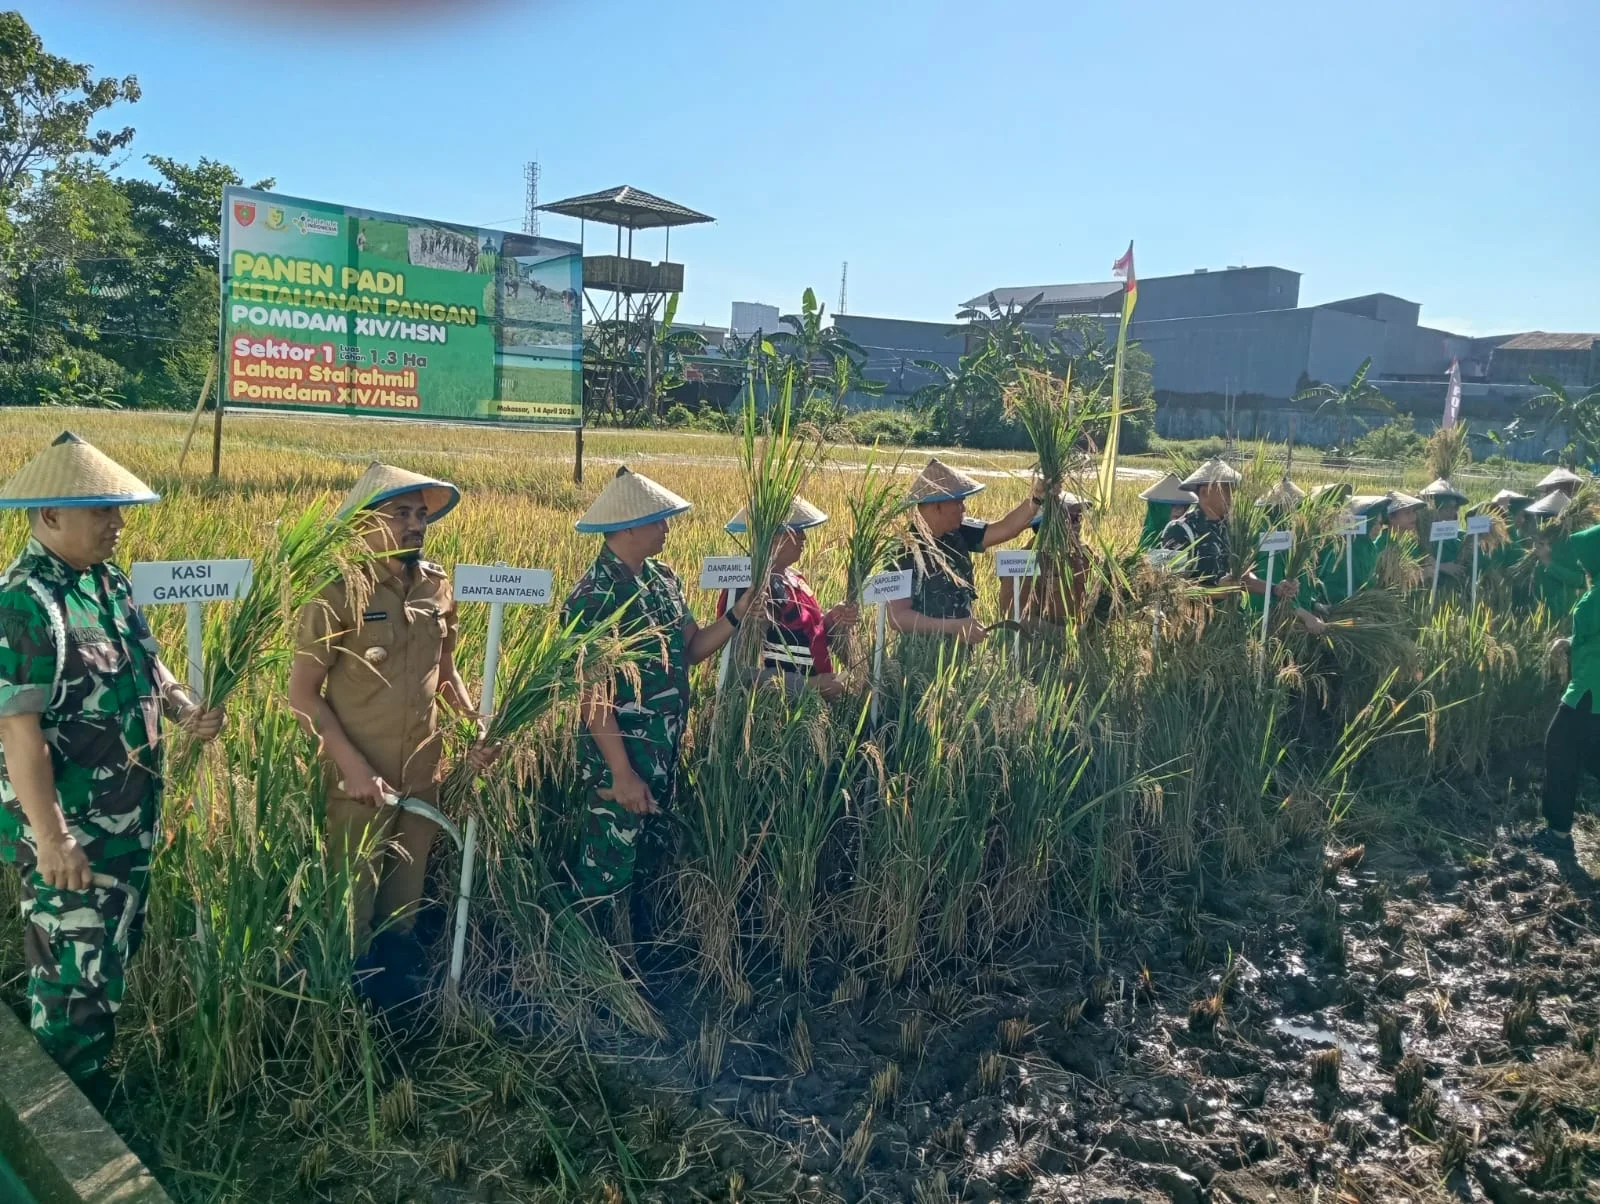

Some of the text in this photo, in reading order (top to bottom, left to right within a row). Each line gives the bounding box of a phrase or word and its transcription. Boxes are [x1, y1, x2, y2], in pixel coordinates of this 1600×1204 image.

[234, 253, 404, 296] PANEN PADI
[232, 281, 476, 326] KETAHANAN PANGAN
[231, 304, 446, 343] POMDAM XIV/HSN
[234, 338, 333, 363] Sektor 1
[340, 344, 360, 352] Luas
[340, 352, 366, 361] Lahan
[370, 349, 428, 368] 1.3 Ha
[233, 359, 415, 388] Lahan Staltahmil
[233, 380, 418, 408] Pomdam XIV/Hsn
[496, 405, 530, 414] Makassar,
[543, 407, 558, 416] April
[171, 565, 212, 580] KASI
[707, 564, 743, 572] DANRAMIL
[489, 574, 522, 584] LURAH
[718, 575, 752, 583] RAPPOCIN
[153, 583, 229, 600] GAKKUM
[461, 586, 545, 597] BANTA BANTAENG
